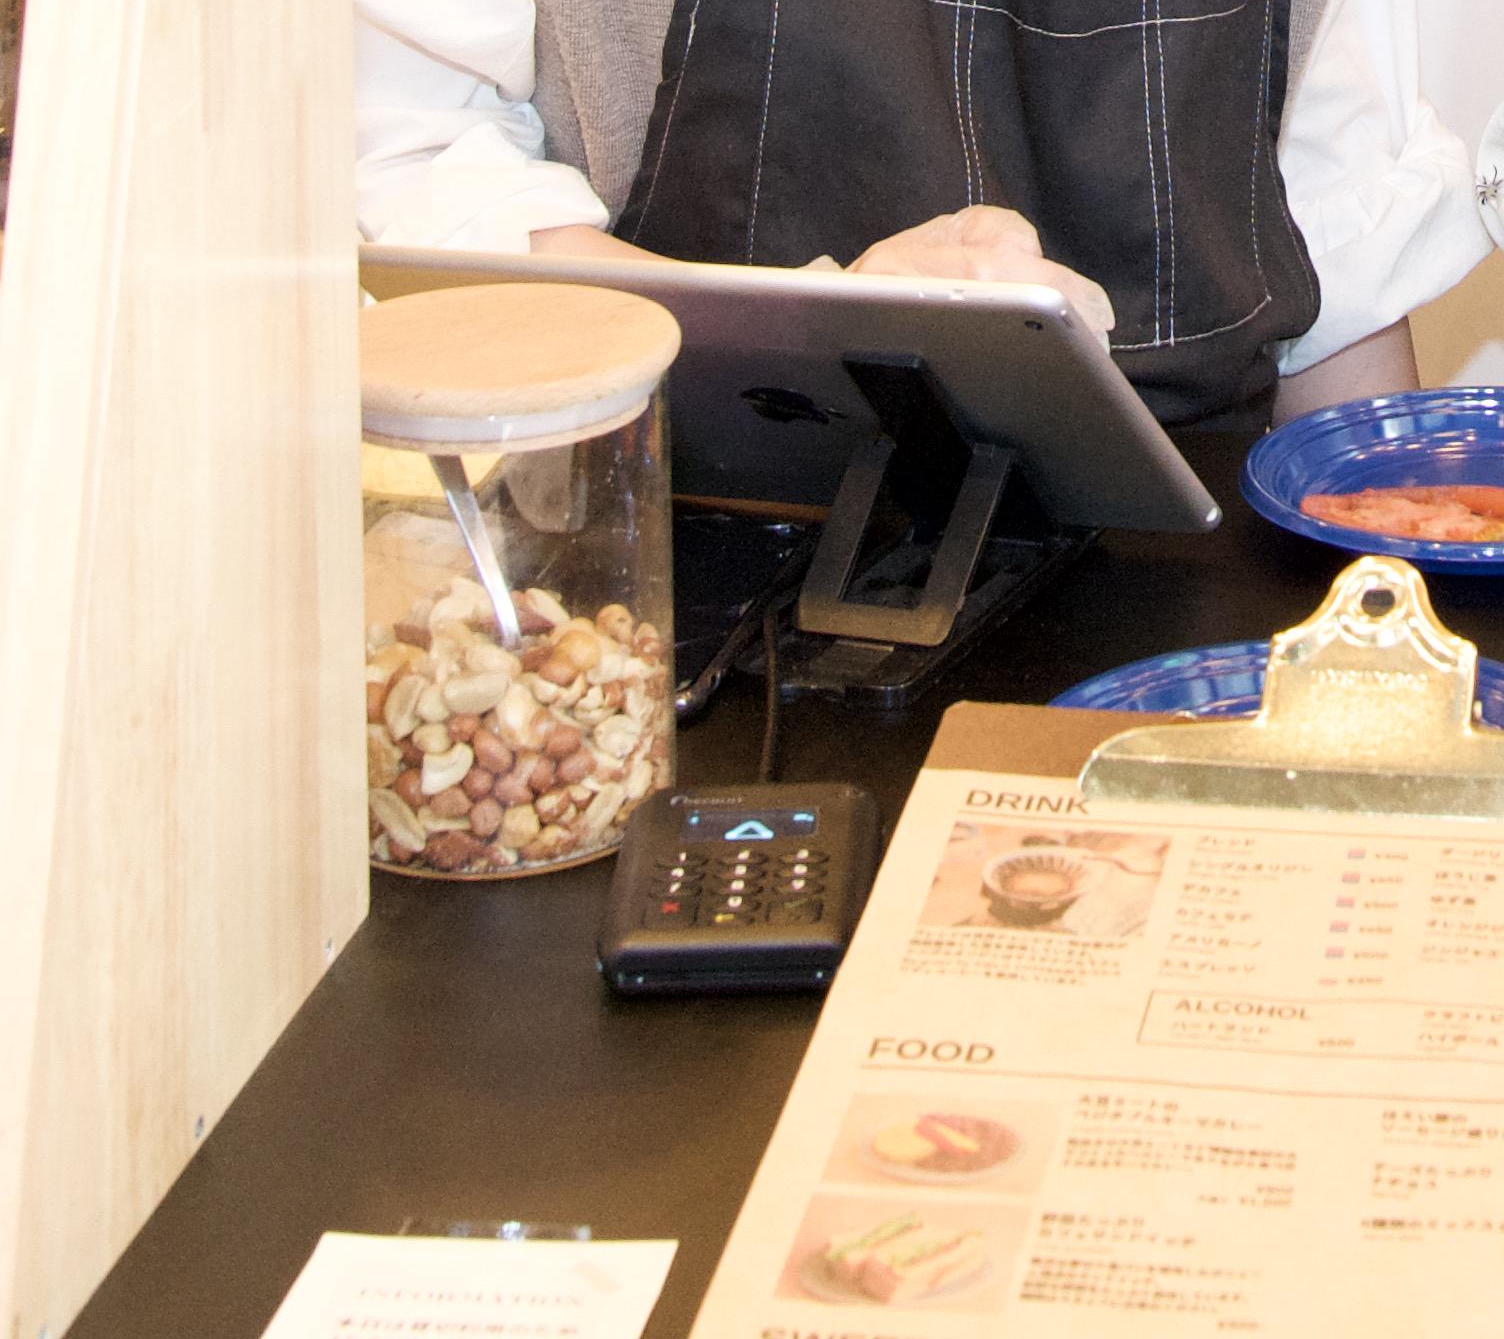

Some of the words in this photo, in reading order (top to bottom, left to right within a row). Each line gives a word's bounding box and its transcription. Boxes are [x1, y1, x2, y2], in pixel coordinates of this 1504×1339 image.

[964, 788, 1091, 816] DRINK
[1174, 998, 1313, 1021] ALCOHOL
[866, 1035, 997, 1066] FOOD
